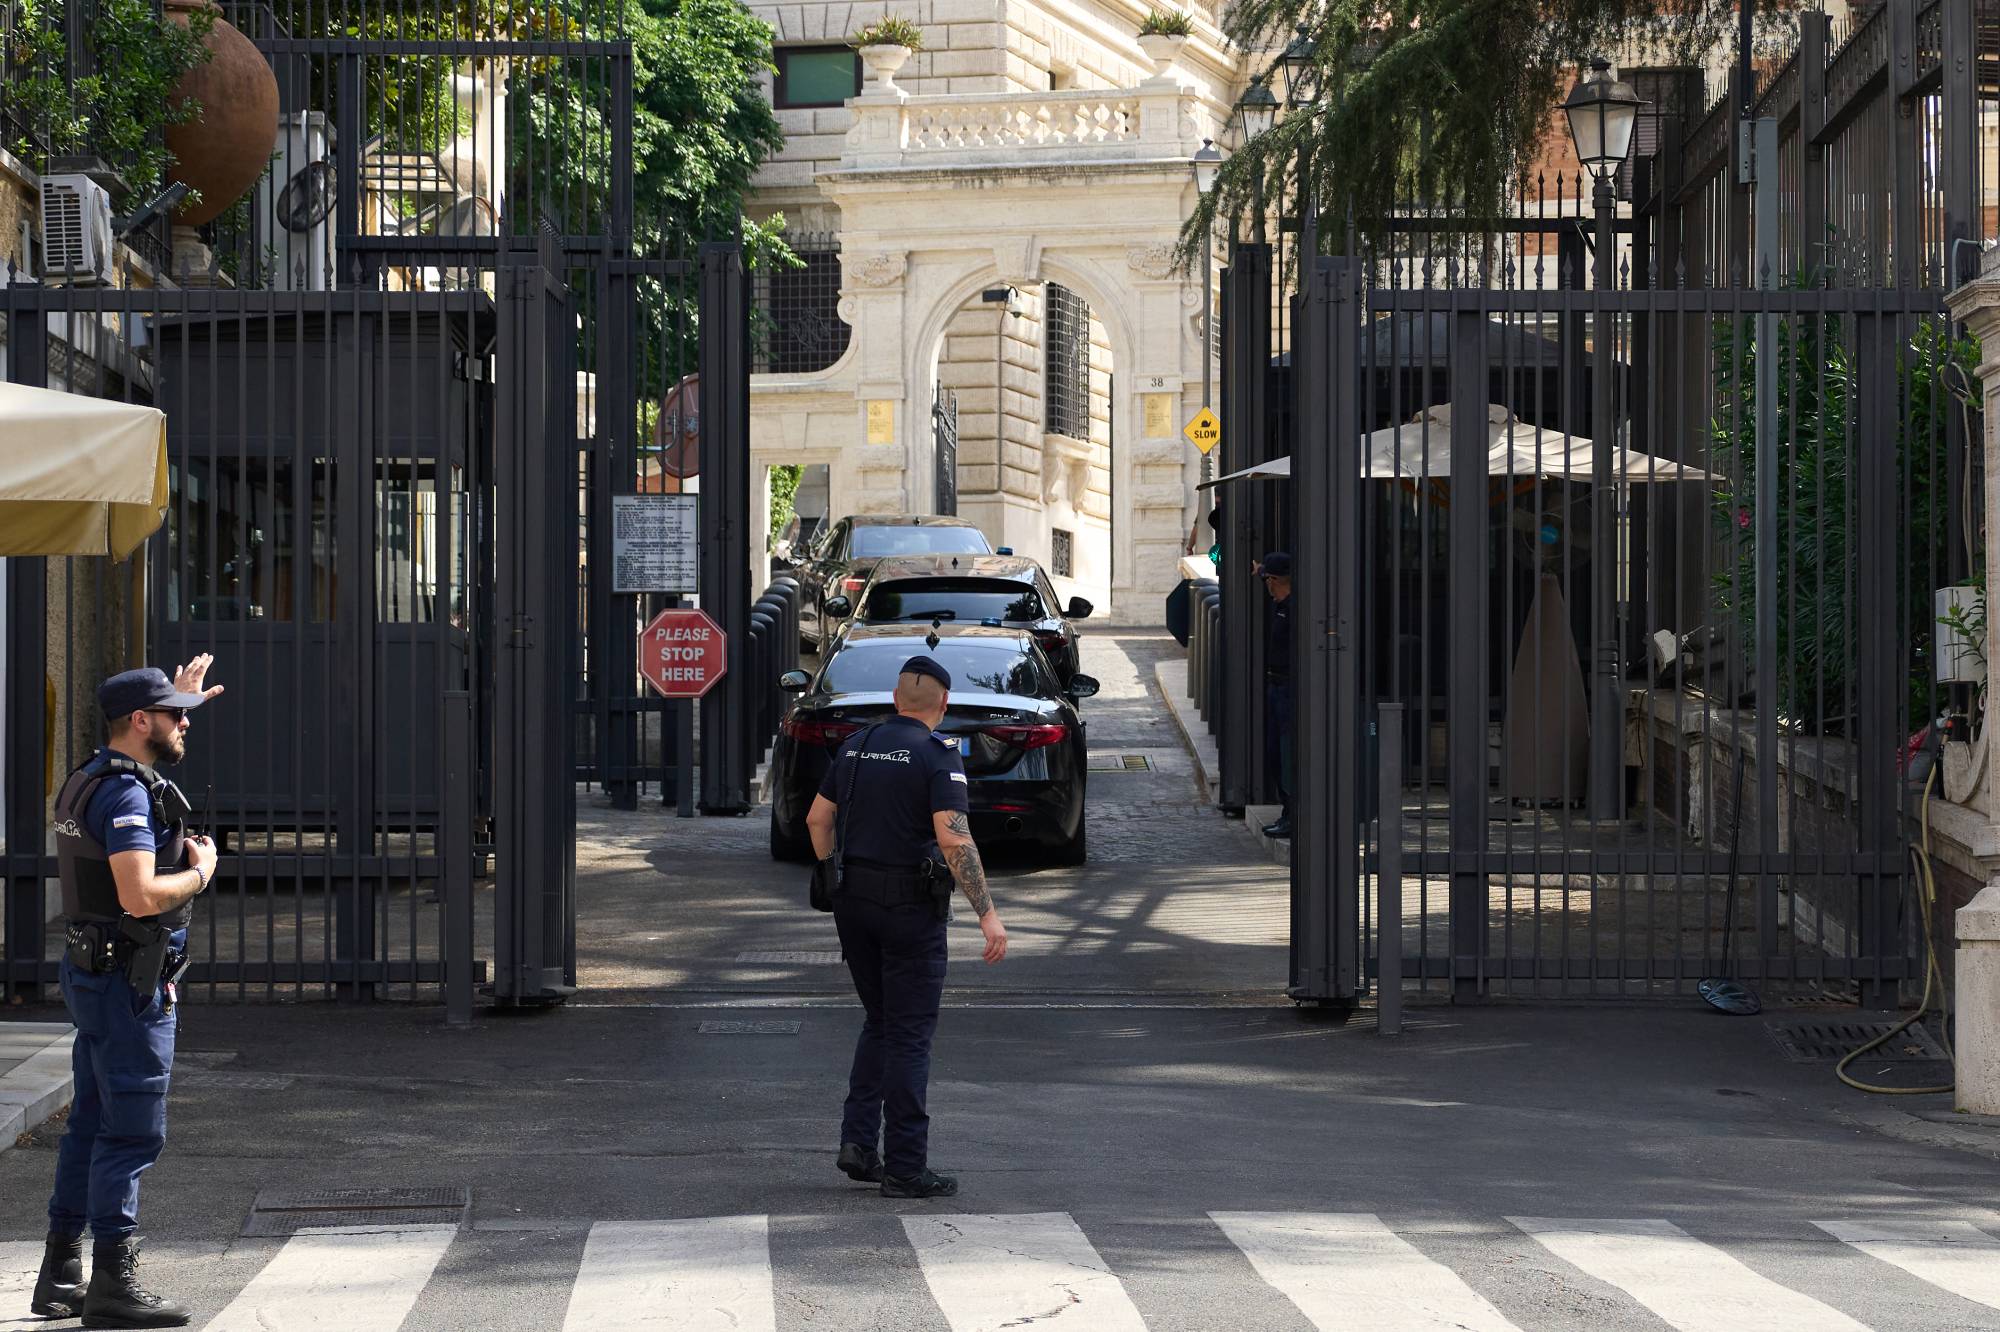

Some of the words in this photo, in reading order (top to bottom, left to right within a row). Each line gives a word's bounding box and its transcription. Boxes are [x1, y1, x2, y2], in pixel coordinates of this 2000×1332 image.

[1151, 377, 1164, 388] 38
[1194, 430, 1217, 439] SLOW
[655, 627, 711, 641] PLEASE
[660, 647, 705, 661] STOP
[661, 667, 705, 682] HERE
